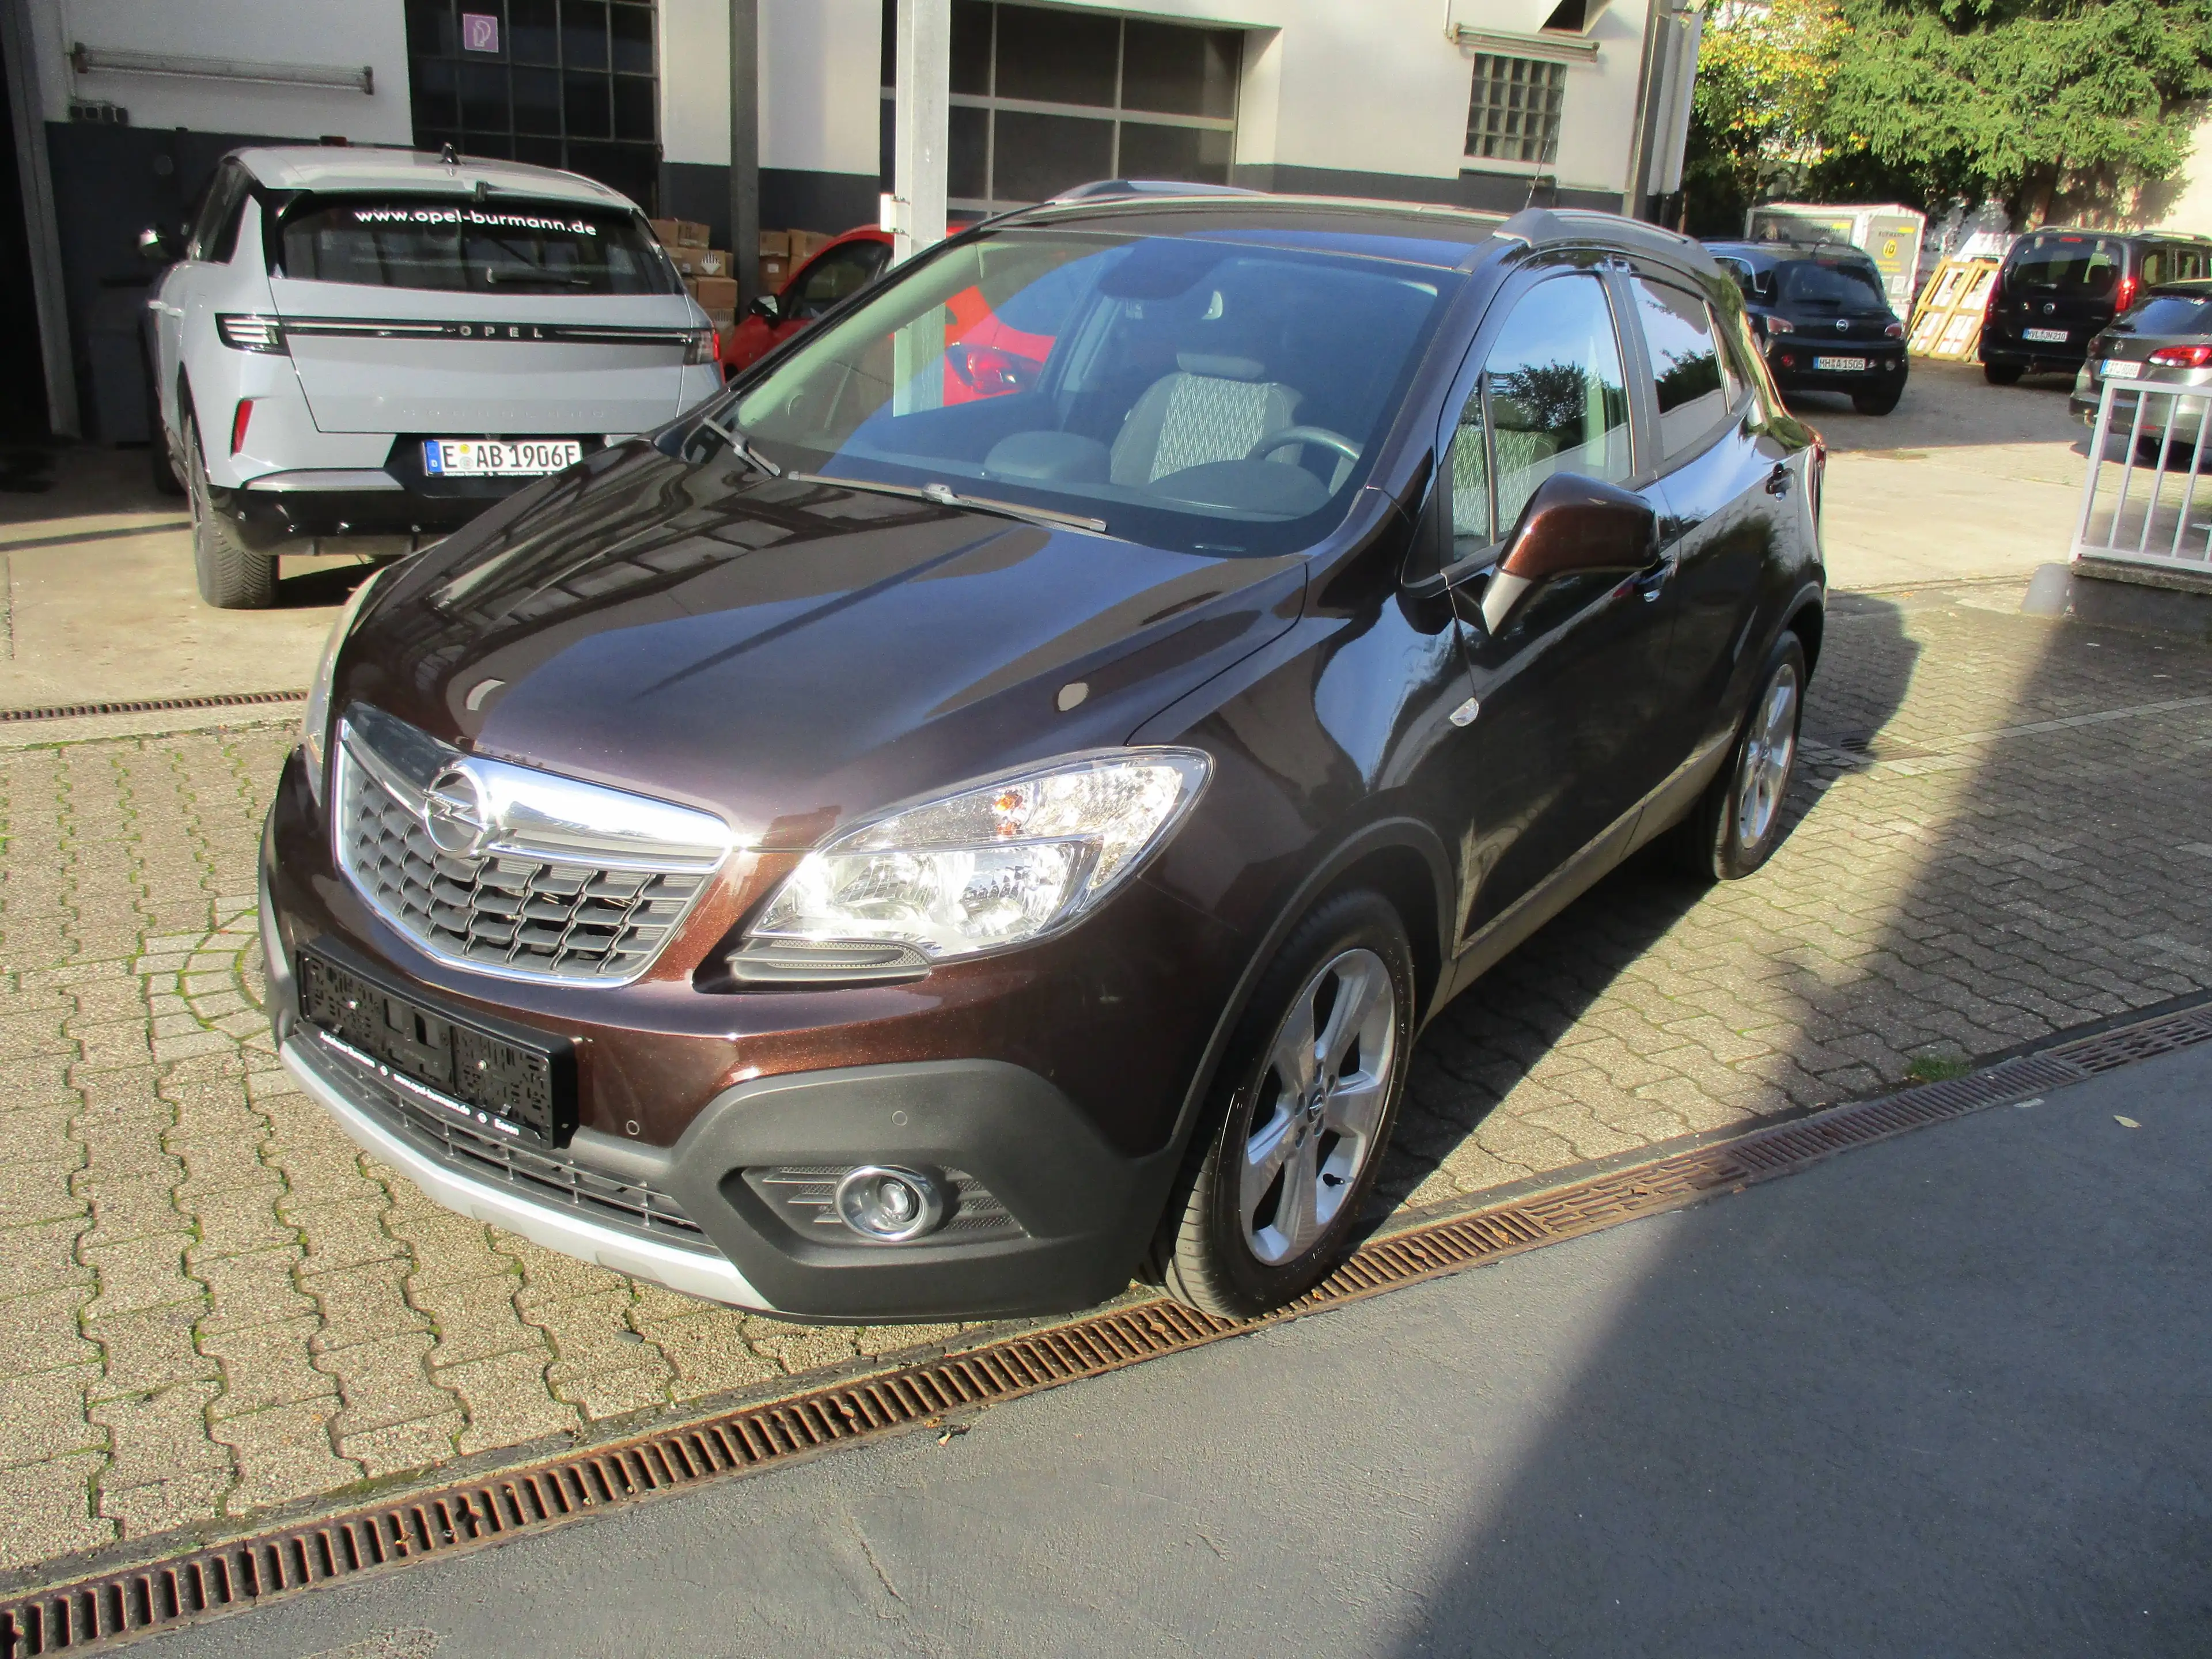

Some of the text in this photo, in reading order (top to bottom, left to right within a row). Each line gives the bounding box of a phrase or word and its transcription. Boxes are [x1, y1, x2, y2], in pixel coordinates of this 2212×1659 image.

[354, 209, 597, 236] www.opel-burmann.de
[460, 325, 543, 339] OPEL
[442, 445, 457, 468] E
[476, 445, 503, 468] AB
